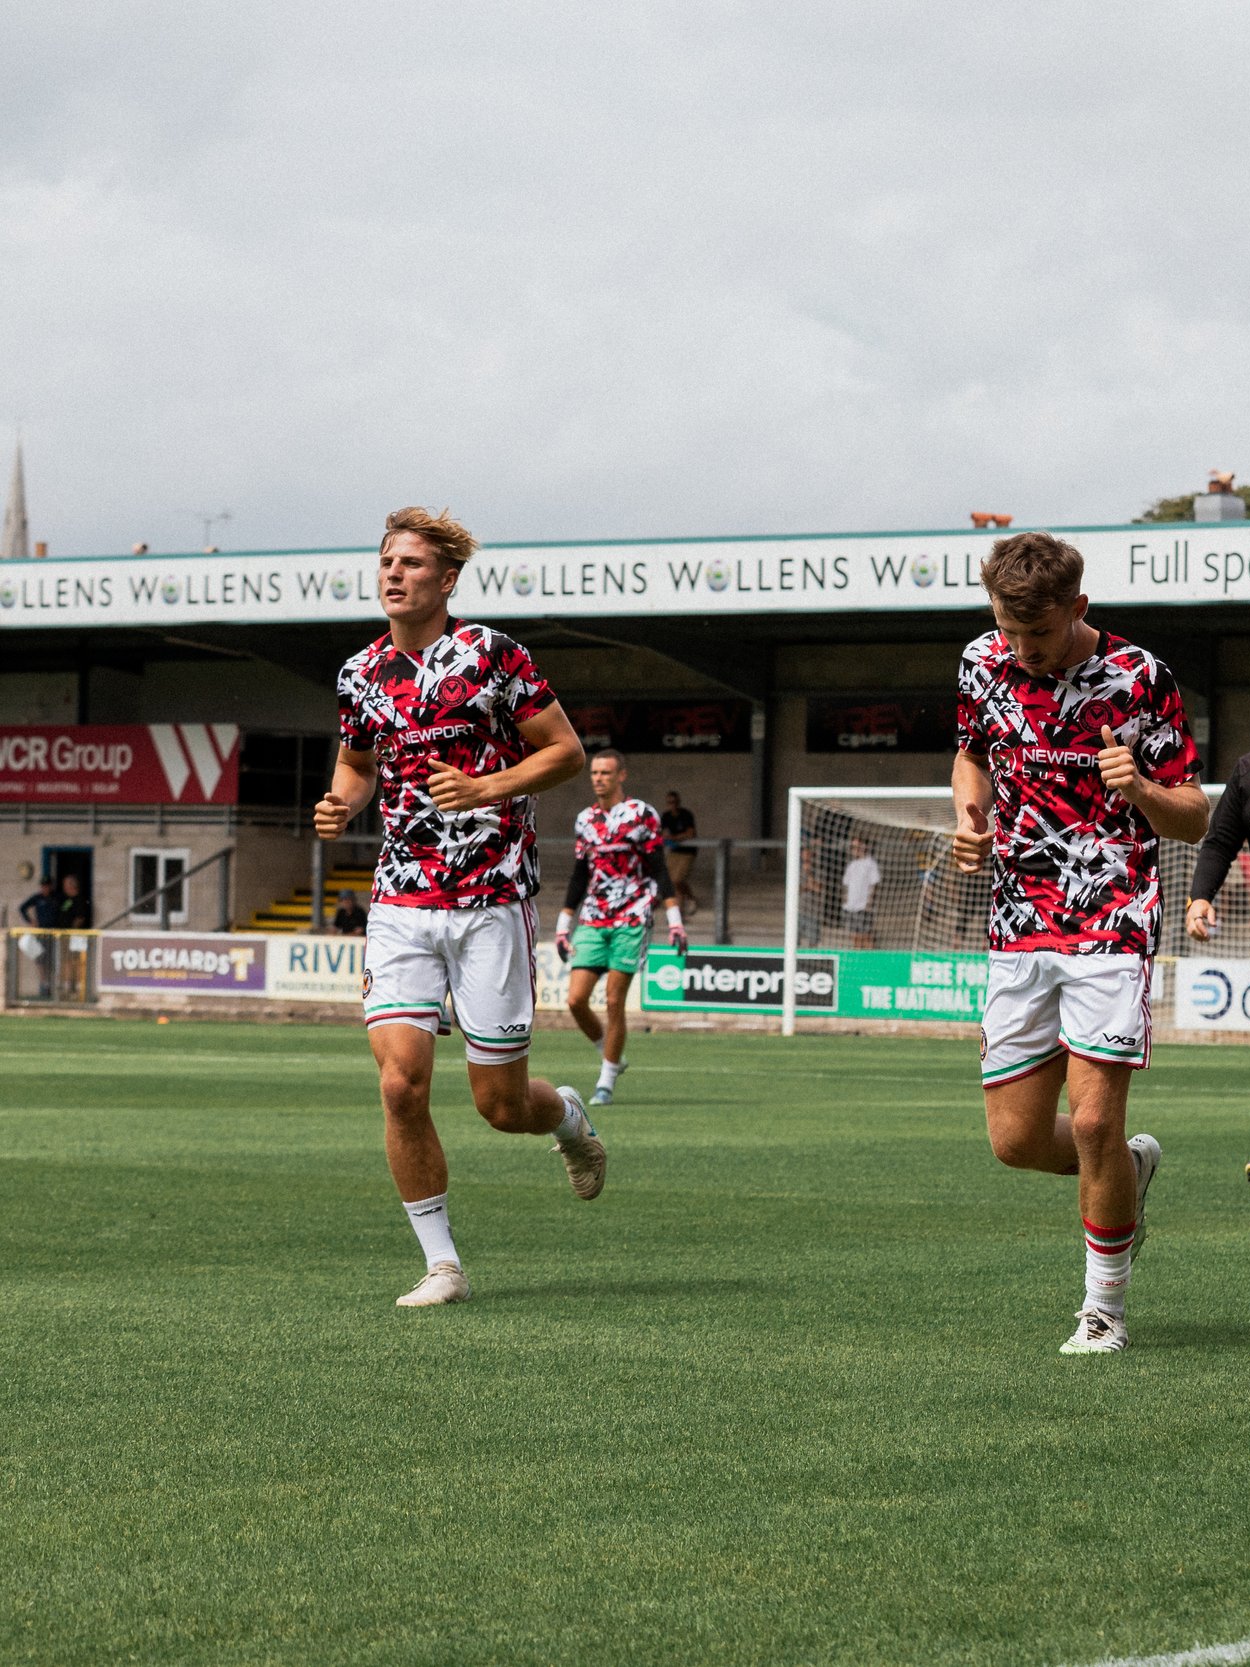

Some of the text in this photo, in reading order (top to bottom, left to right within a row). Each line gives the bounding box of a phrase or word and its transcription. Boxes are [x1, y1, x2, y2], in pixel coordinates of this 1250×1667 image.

[476, 551, 980, 597] WOLLENS WOLLENS WOLL
[1129, 540, 1189, 584] Full
[0, 577, 113, 609] OLLENS
[129, 572, 282, 606] WOLLENS
[398, 724, 477, 745] NEWPORT
[52, 736, 133, 778] Group
[1022, 748, 1100, 768] NEWPOR
[111, 947, 230, 975] TOLCHARDS
[911, 961, 953, 986] HERE
[655, 964, 834, 1000] enterprse
[861, 986, 892, 1010] THE
[895, 986, 974, 1012] NATIONAL
[498, 1024, 527, 1033] VX3
[1103, 1033, 1136, 1046] VX3
